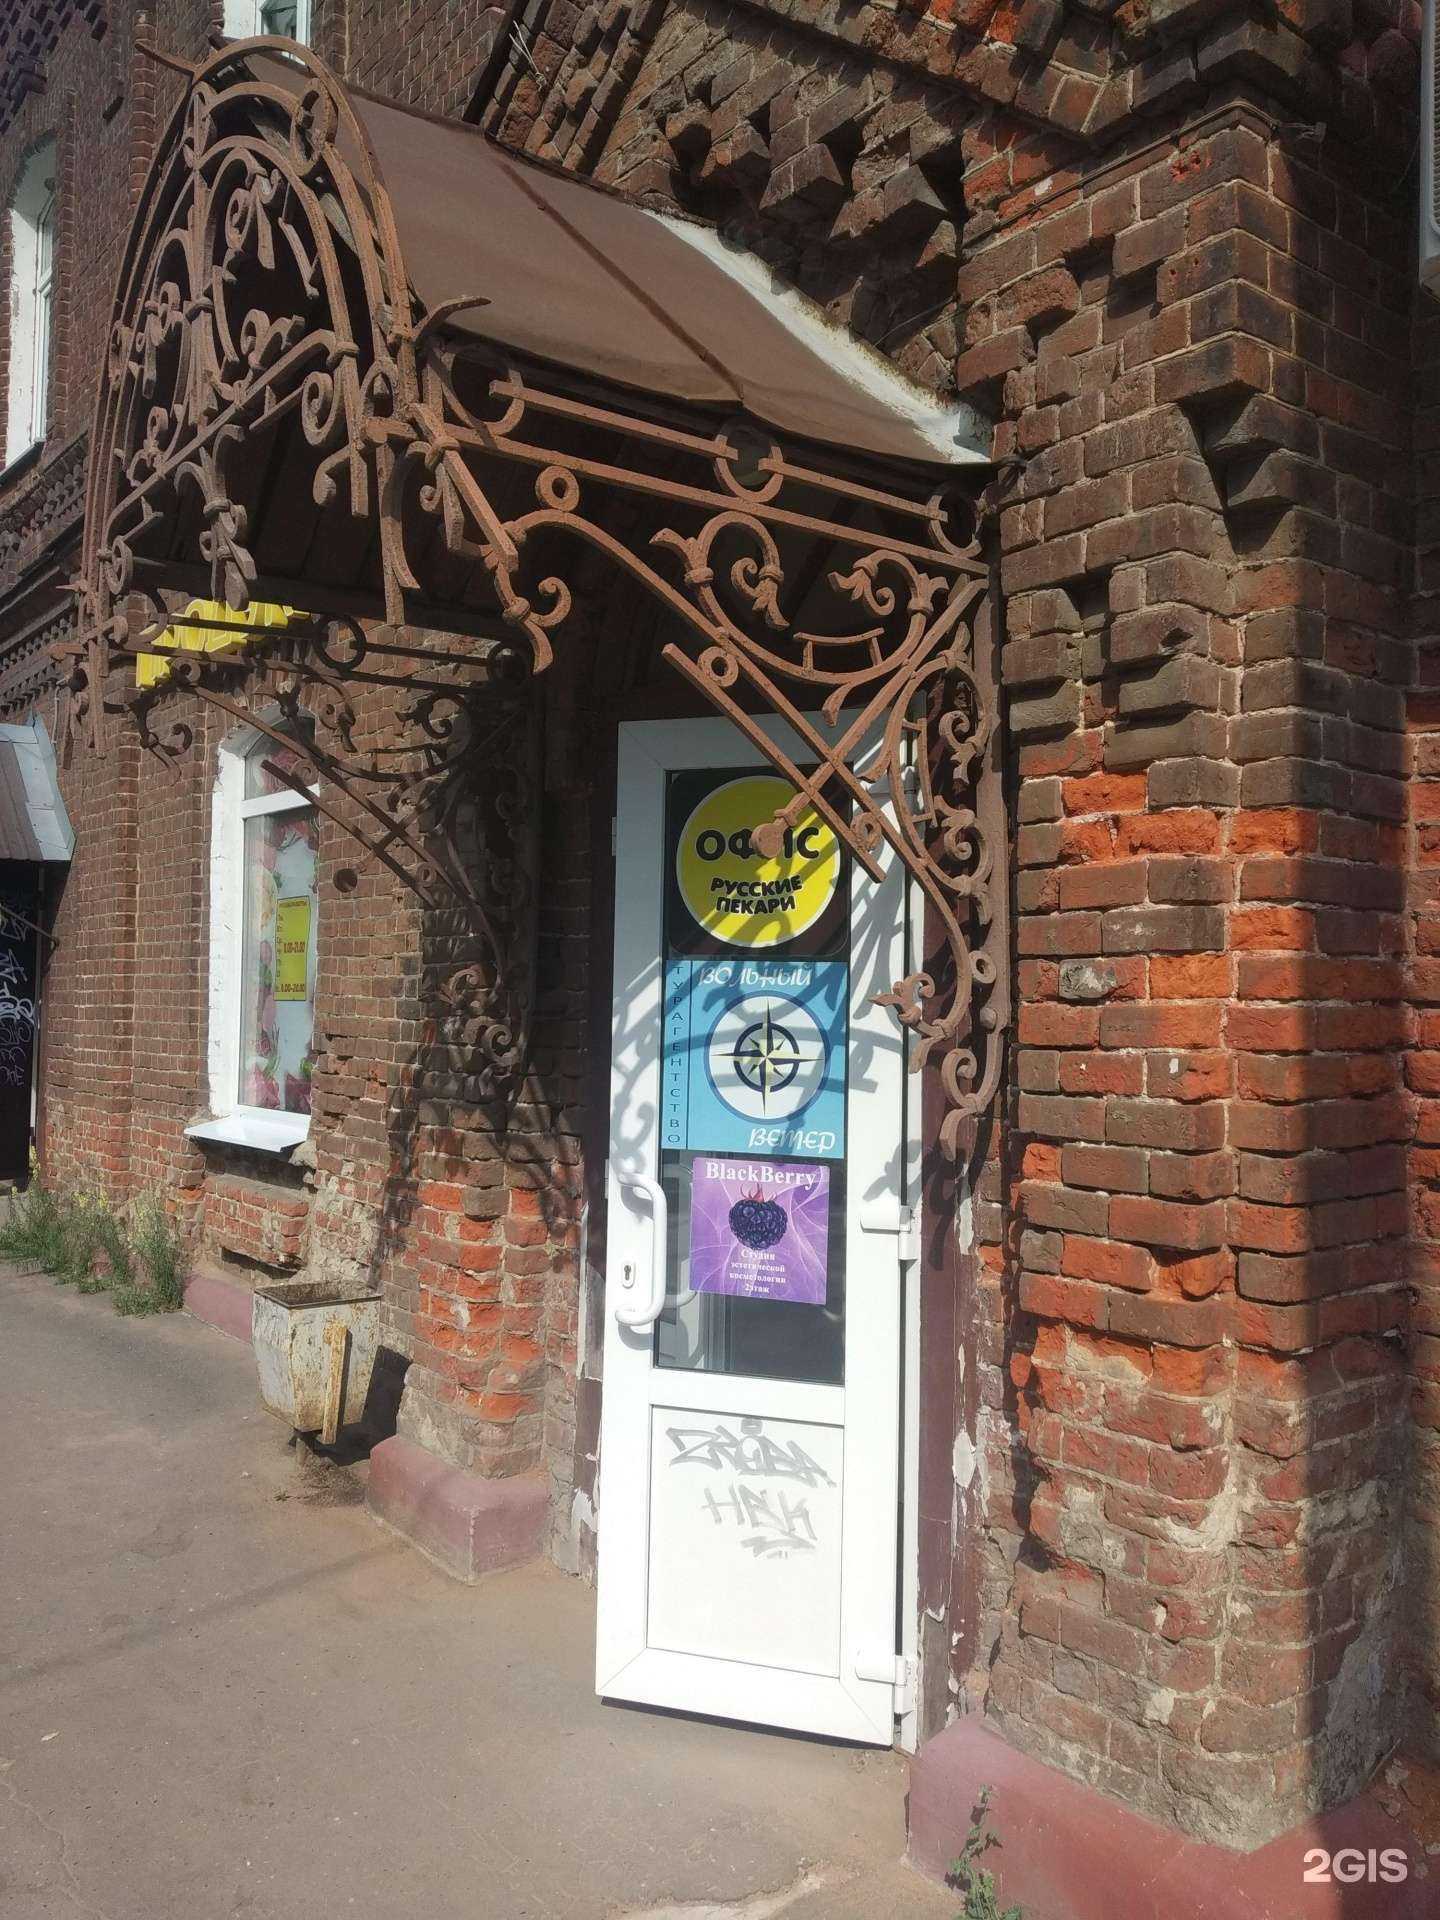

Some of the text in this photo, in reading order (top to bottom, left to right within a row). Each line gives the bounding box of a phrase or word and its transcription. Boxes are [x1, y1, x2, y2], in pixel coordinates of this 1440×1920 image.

[710, 875, 803, 897] РУССКИЕ
[716, 896, 796, 914] ПЕКАРИ
[667, 966, 684, 1143] ТУРАГЕНТСТВО
[705, 1161, 816, 1190] BlackBerry
